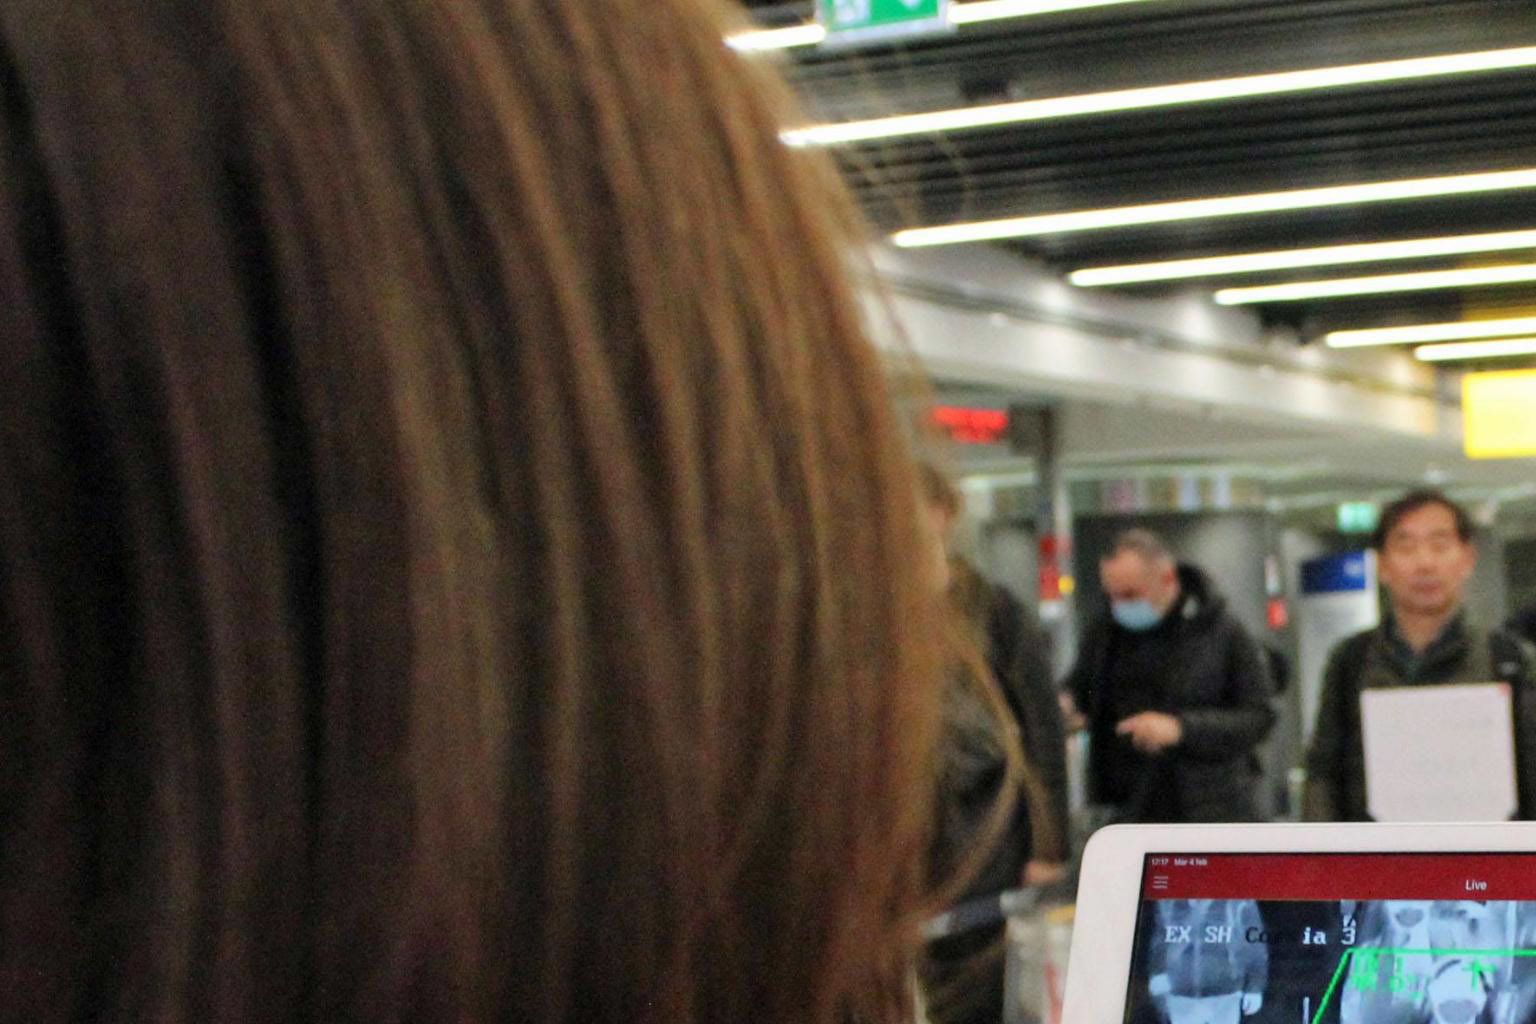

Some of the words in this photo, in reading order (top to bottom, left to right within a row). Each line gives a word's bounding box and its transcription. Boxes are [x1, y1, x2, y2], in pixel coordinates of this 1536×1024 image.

[1465, 879, 1487, 891] Live
[1164, 926, 1191, 943] EX
[1204, 926, 1232, 943] SH
[1341, 927, 1356, 945] 3
